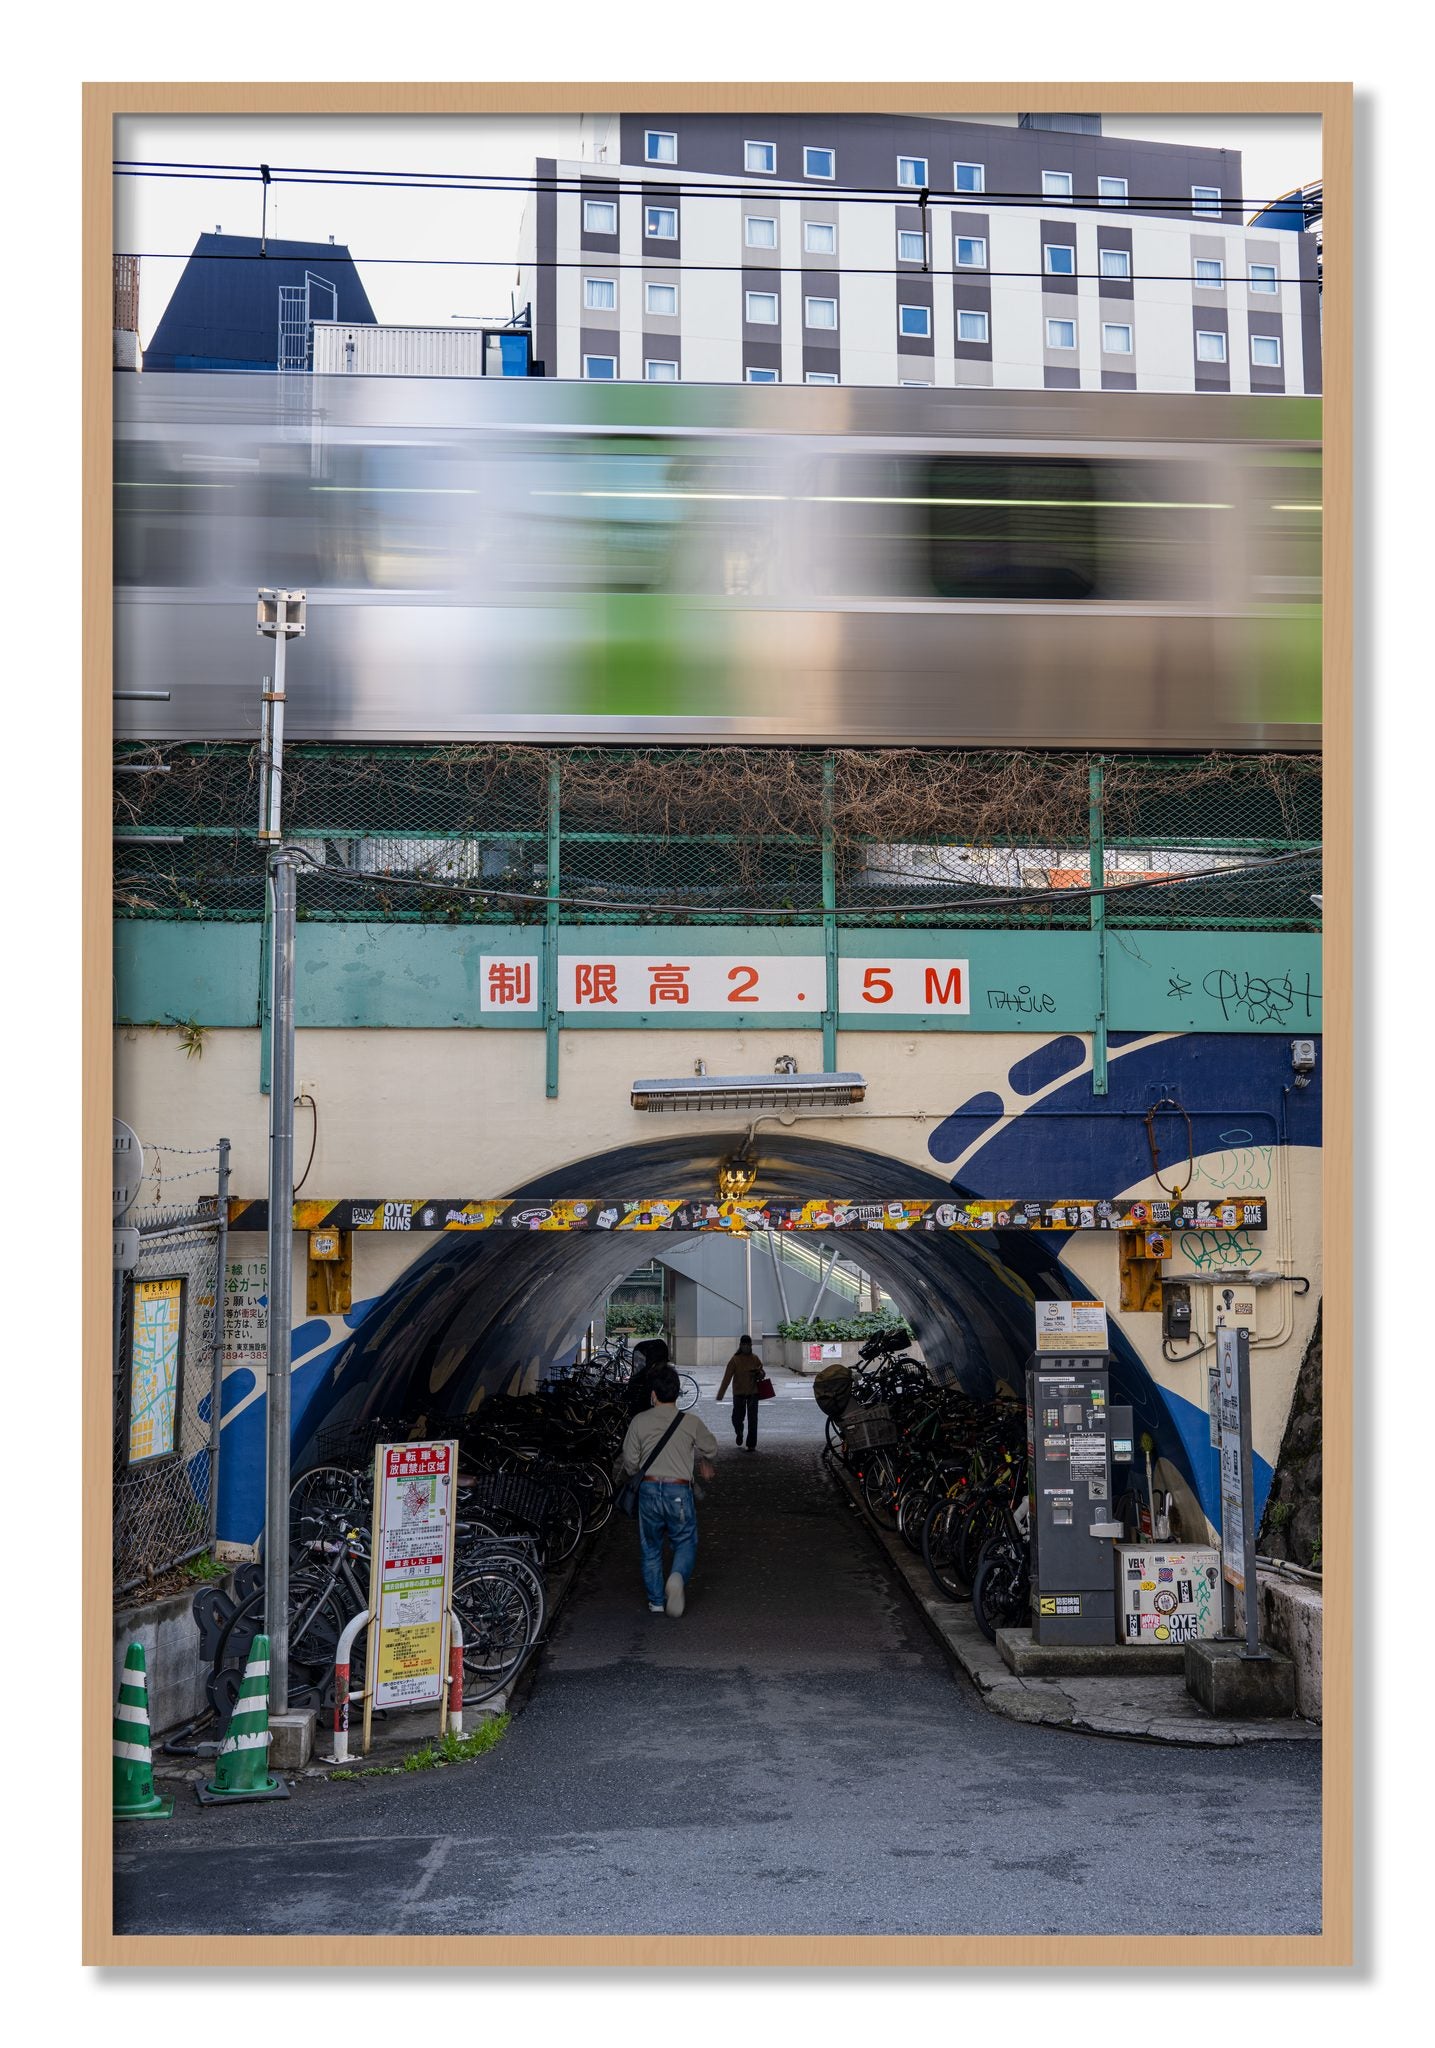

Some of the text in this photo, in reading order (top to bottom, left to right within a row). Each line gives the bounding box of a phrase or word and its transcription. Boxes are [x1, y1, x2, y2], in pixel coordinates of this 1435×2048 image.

[384, 1202, 412, 1217] OYE
[1243, 1205, 1261, 1214] OYE
[383, 1216, 412, 1231] RUNS
[1244, 1214, 1262, 1223] RUNS
[390, 1449, 447, 1463] 自転車等
[389, 1460, 446, 1475] 放置禁止区域
[1169, 1615, 1197, 1629] OYE
[1170, 1628, 1198, 1644] RUNS
